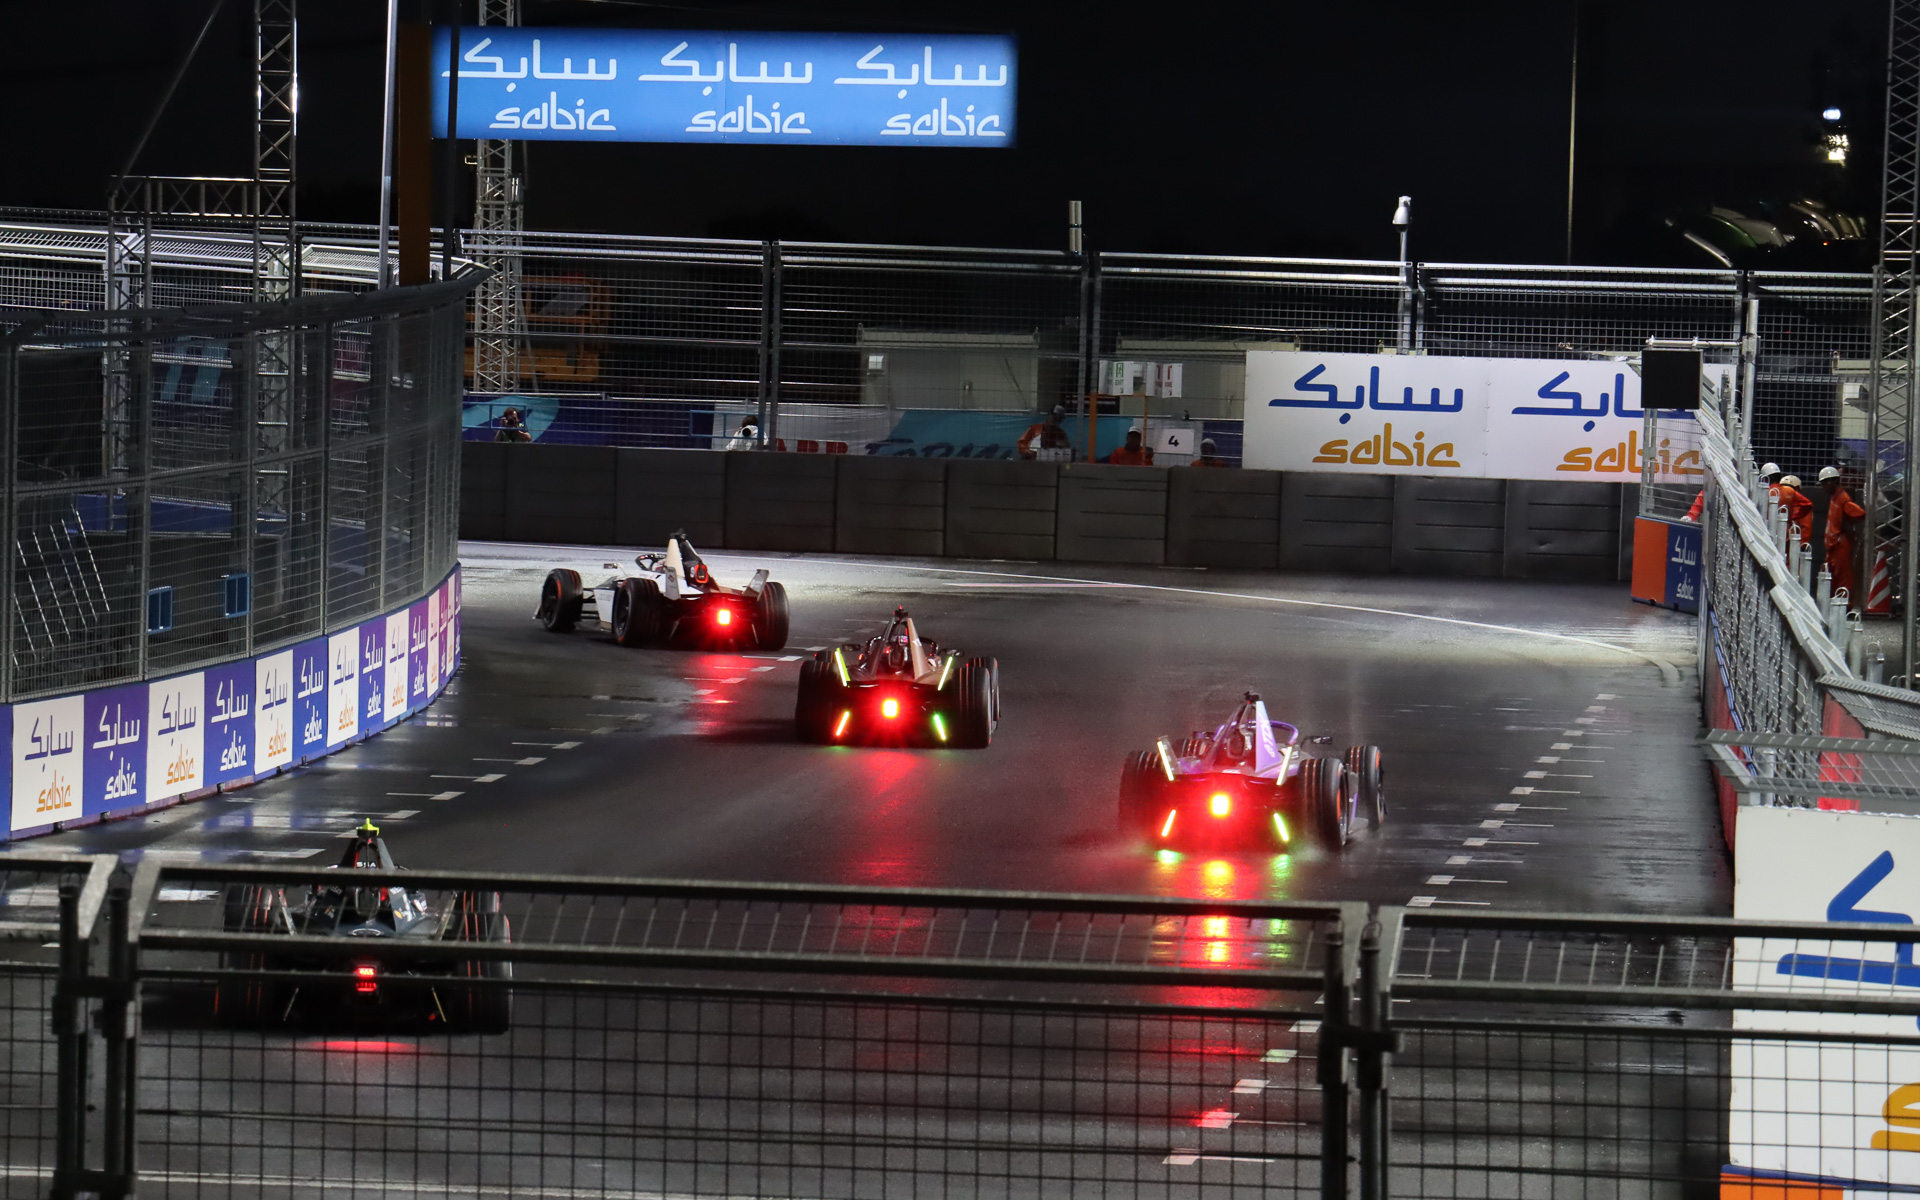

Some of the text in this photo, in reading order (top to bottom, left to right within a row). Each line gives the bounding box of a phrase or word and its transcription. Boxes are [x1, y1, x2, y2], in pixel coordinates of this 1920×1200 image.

[442, 38, 617, 93] سابك
[638, 41, 812, 96] سابك
[833, 45, 1007, 99] سابك
[489, 91, 616, 131] sabic
[685, 94, 812, 135] sabic
[879, 97, 1006, 137] sabic
[1268, 363, 1464, 425] سابك
[1168, 435, 1179, 447] 4
[1312, 422, 1461, 469] sabic
[157, 691, 197, 747] سابك
[210, 679, 249, 734] سابك
[25, 714, 73, 773] سابك
[92, 703, 141, 761] سابك
[219, 729, 247, 772] sabic
[104, 757, 138, 800] sabic
[166, 743, 195, 785] sabic
[36, 769, 72, 813] sabic
